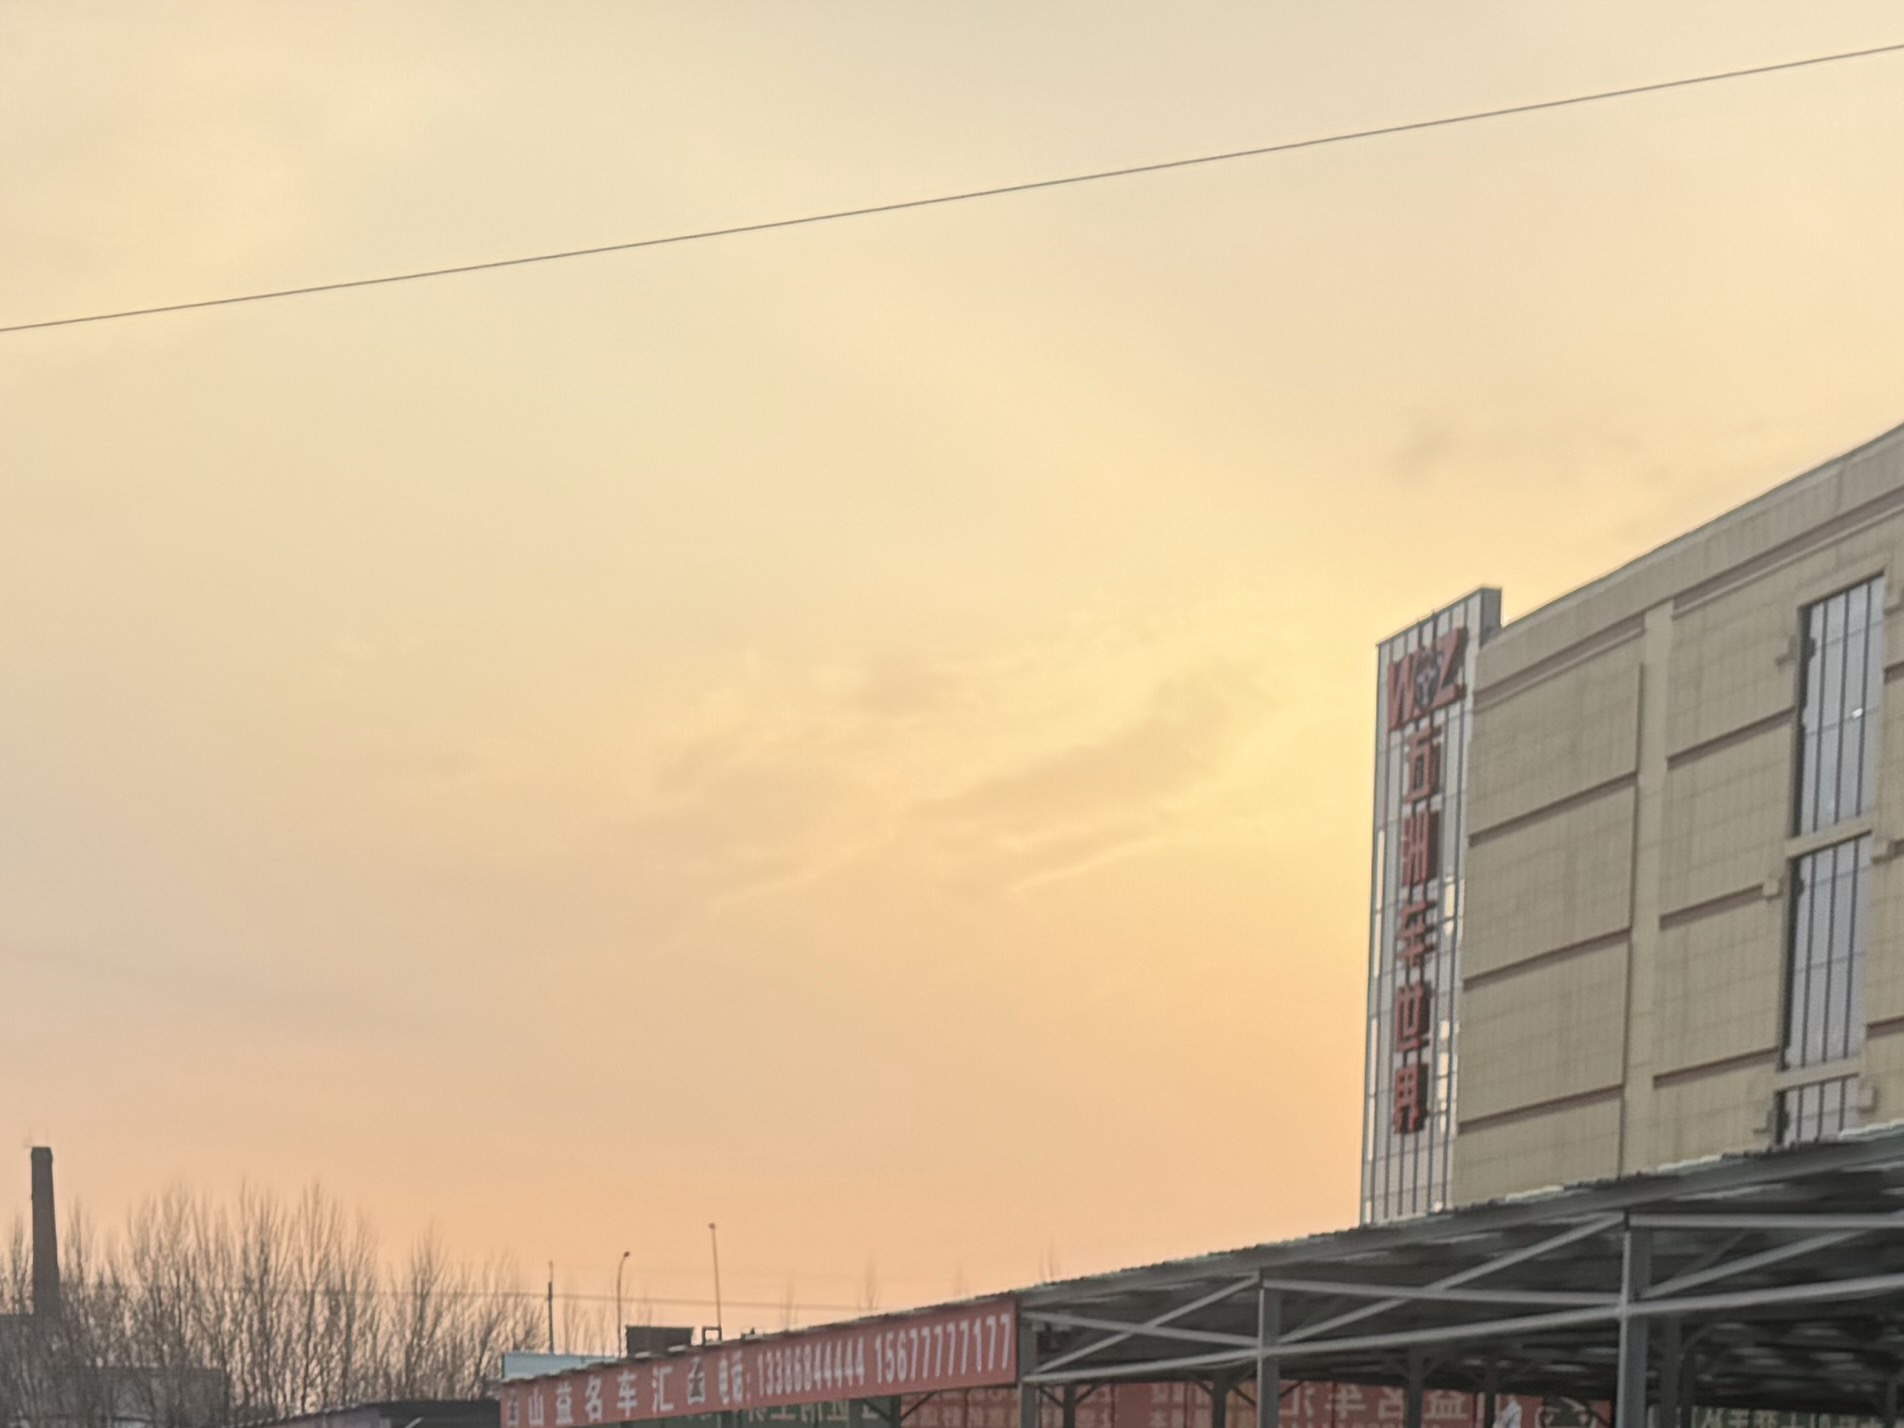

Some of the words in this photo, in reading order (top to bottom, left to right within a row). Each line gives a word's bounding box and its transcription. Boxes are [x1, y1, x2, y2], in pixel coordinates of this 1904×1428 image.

[1394, 725, 1442, 1136] 五洲车世界
